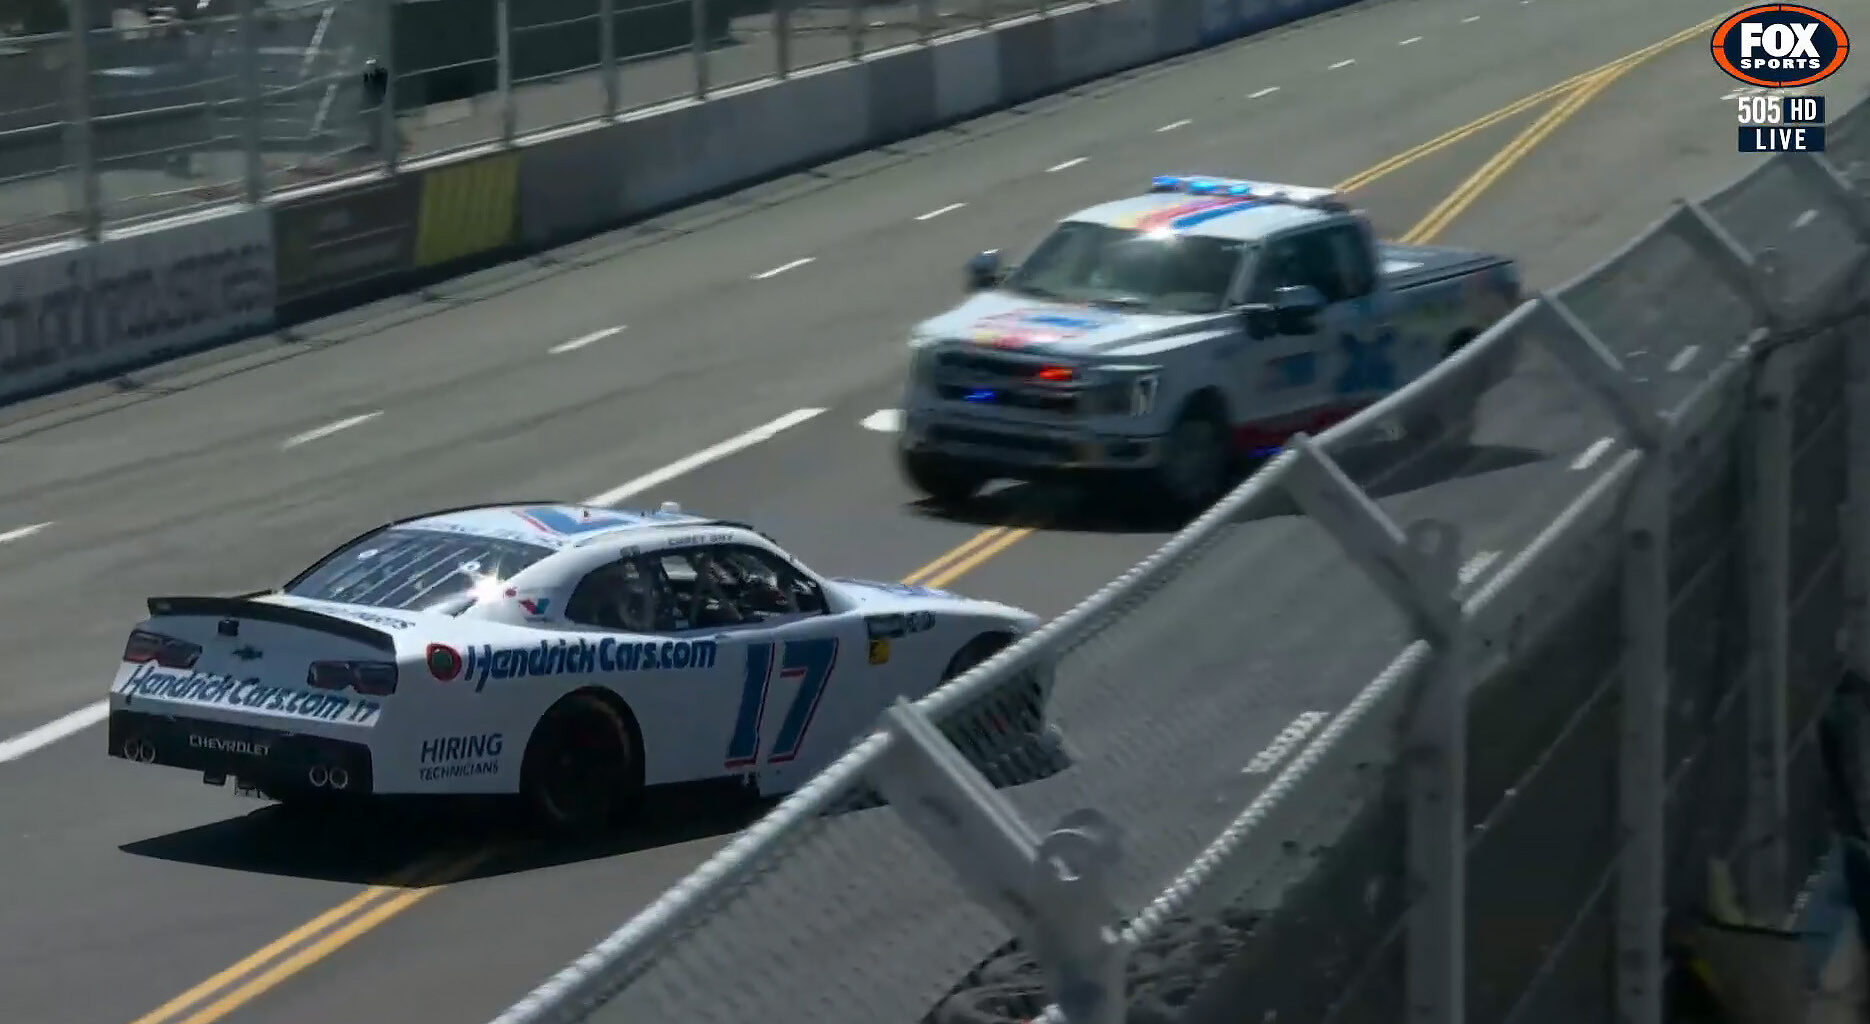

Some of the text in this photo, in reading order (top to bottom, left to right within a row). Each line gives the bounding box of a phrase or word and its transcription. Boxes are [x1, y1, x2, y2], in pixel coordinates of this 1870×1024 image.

[724, 637, 839, 769] 17
[188, 734, 271, 757] CHEVROLET
[421, 733, 503, 764] HIRING
[419, 760, 499, 781] TECHNICIANS
